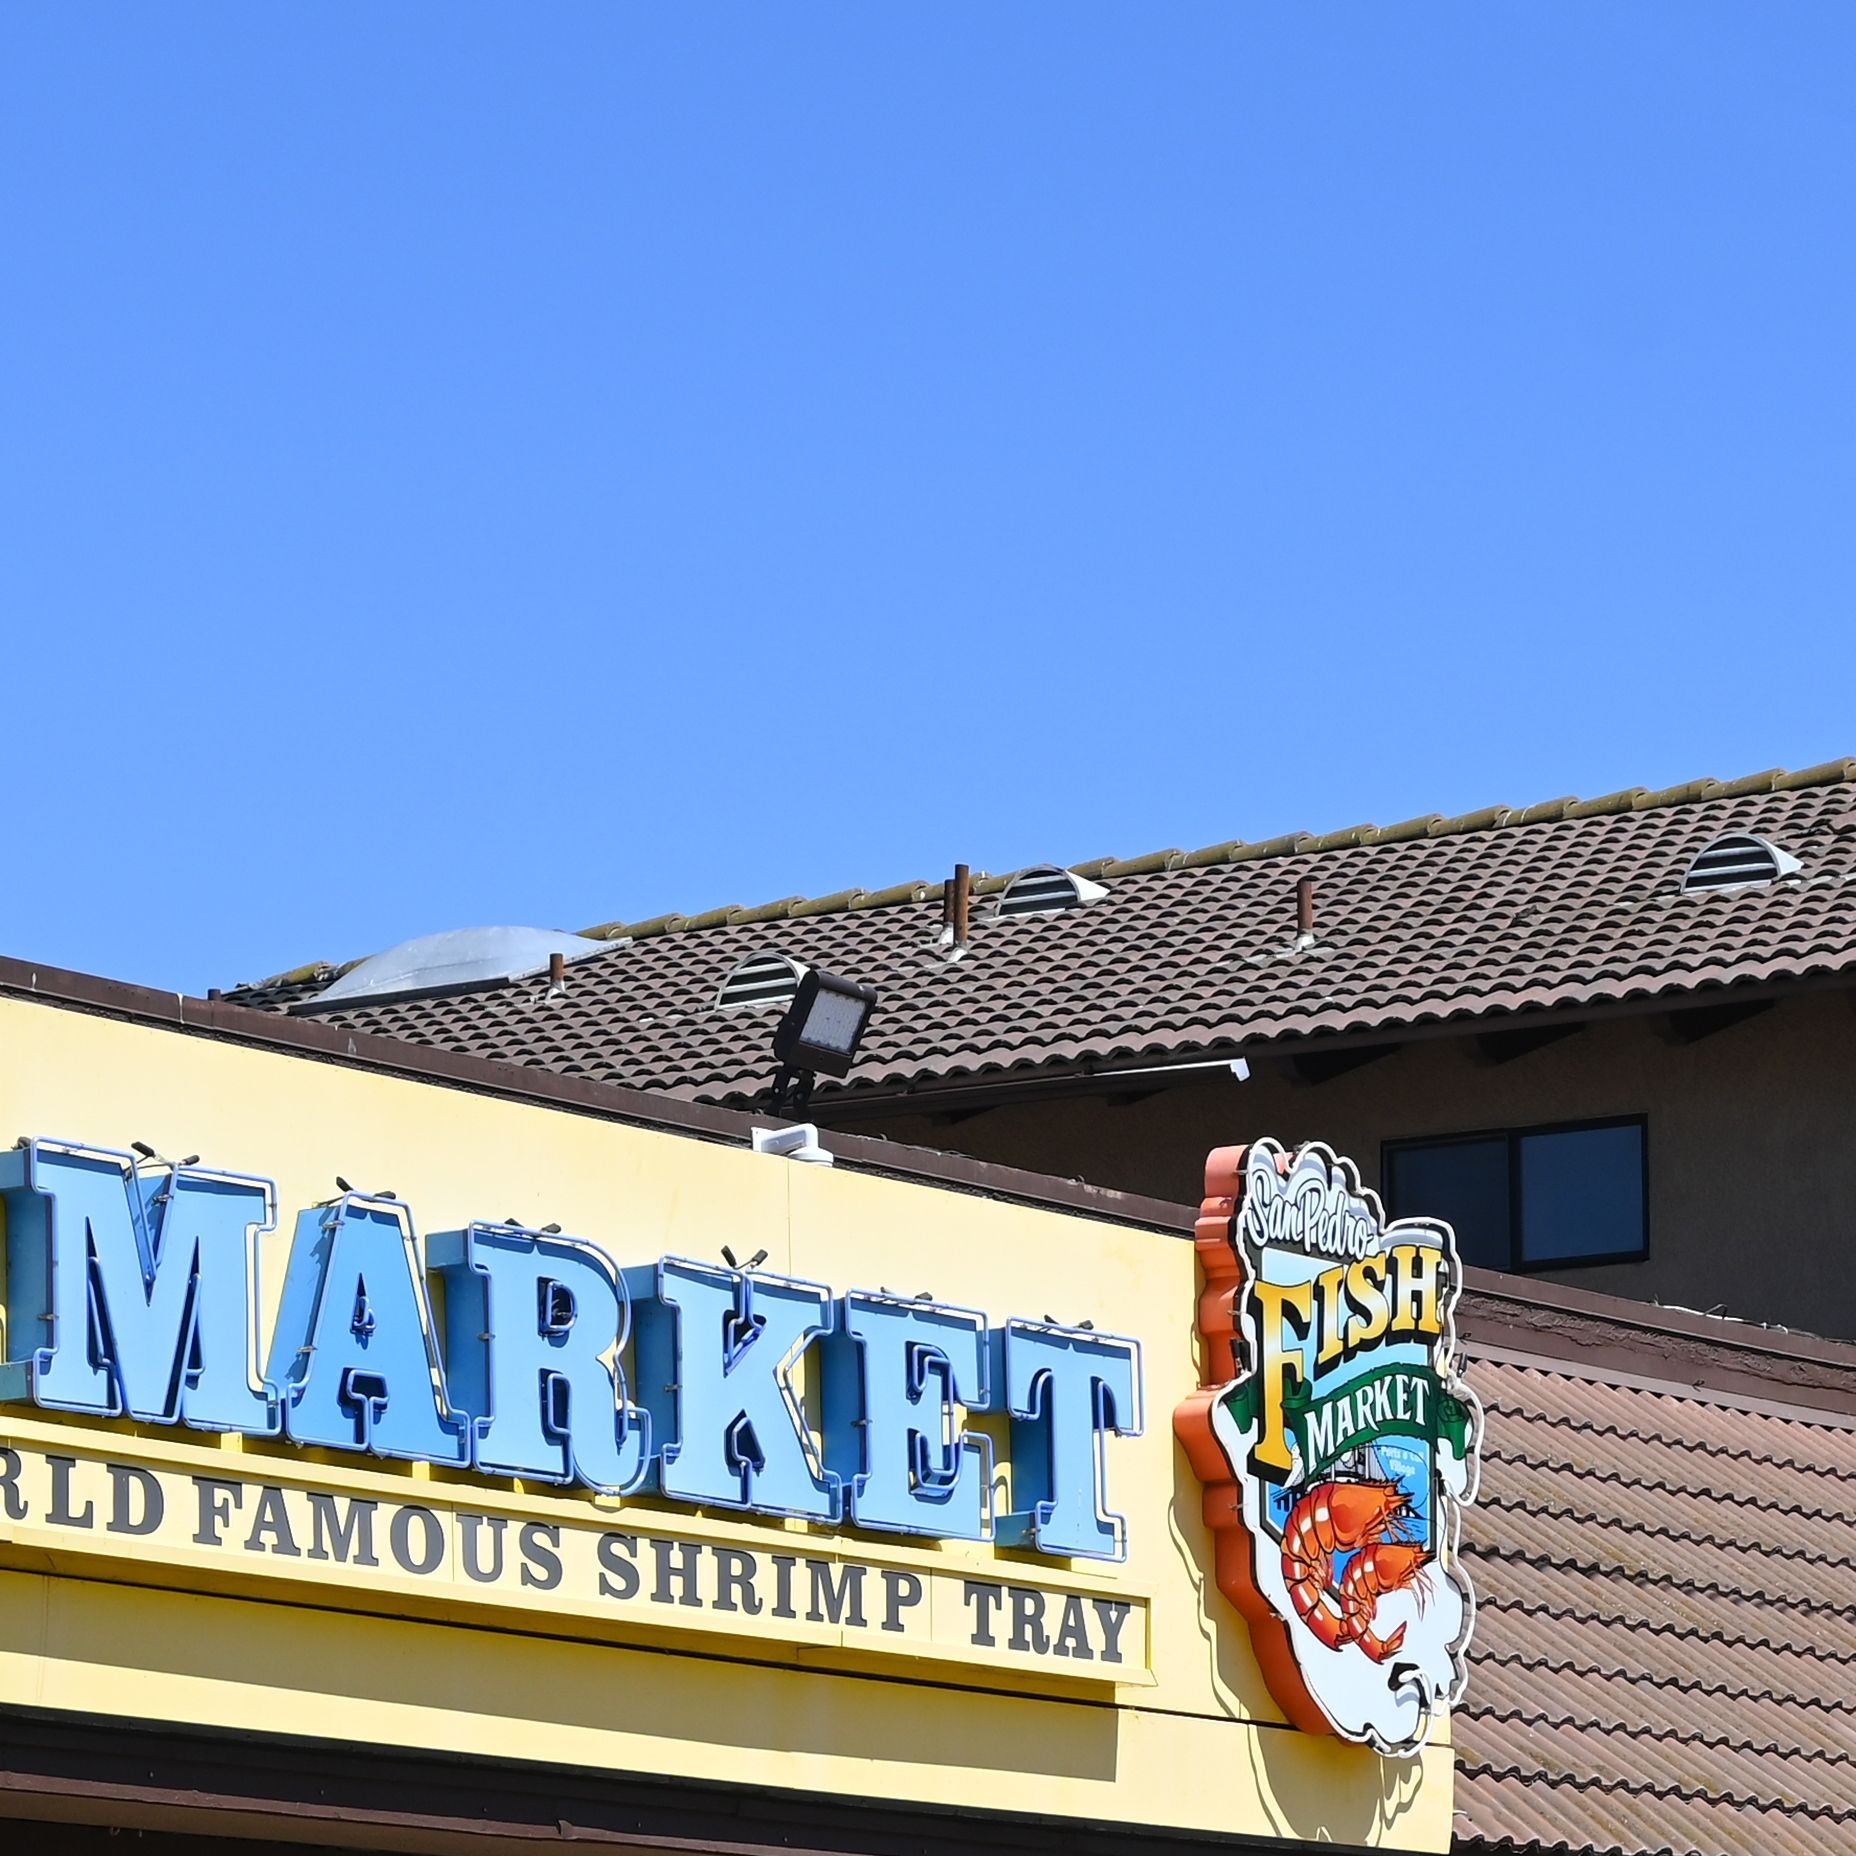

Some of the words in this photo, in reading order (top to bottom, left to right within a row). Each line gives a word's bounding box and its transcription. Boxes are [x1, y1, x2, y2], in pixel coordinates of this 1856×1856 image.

[1244, 1168, 1304, 1248] San
[1296, 1177, 1374, 1261] Pedro
[4, 1134, 1144, 1563] MARKET
[1254, 1244, 1442, 1471] FISH
[1304, 1373, 1430, 1473] MARKET
[192, 1474, 564, 1591] FAMOUS
[596, 1531, 923, 1634] SHRIMP
[963, 1579, 1131, 1664] TRAY
